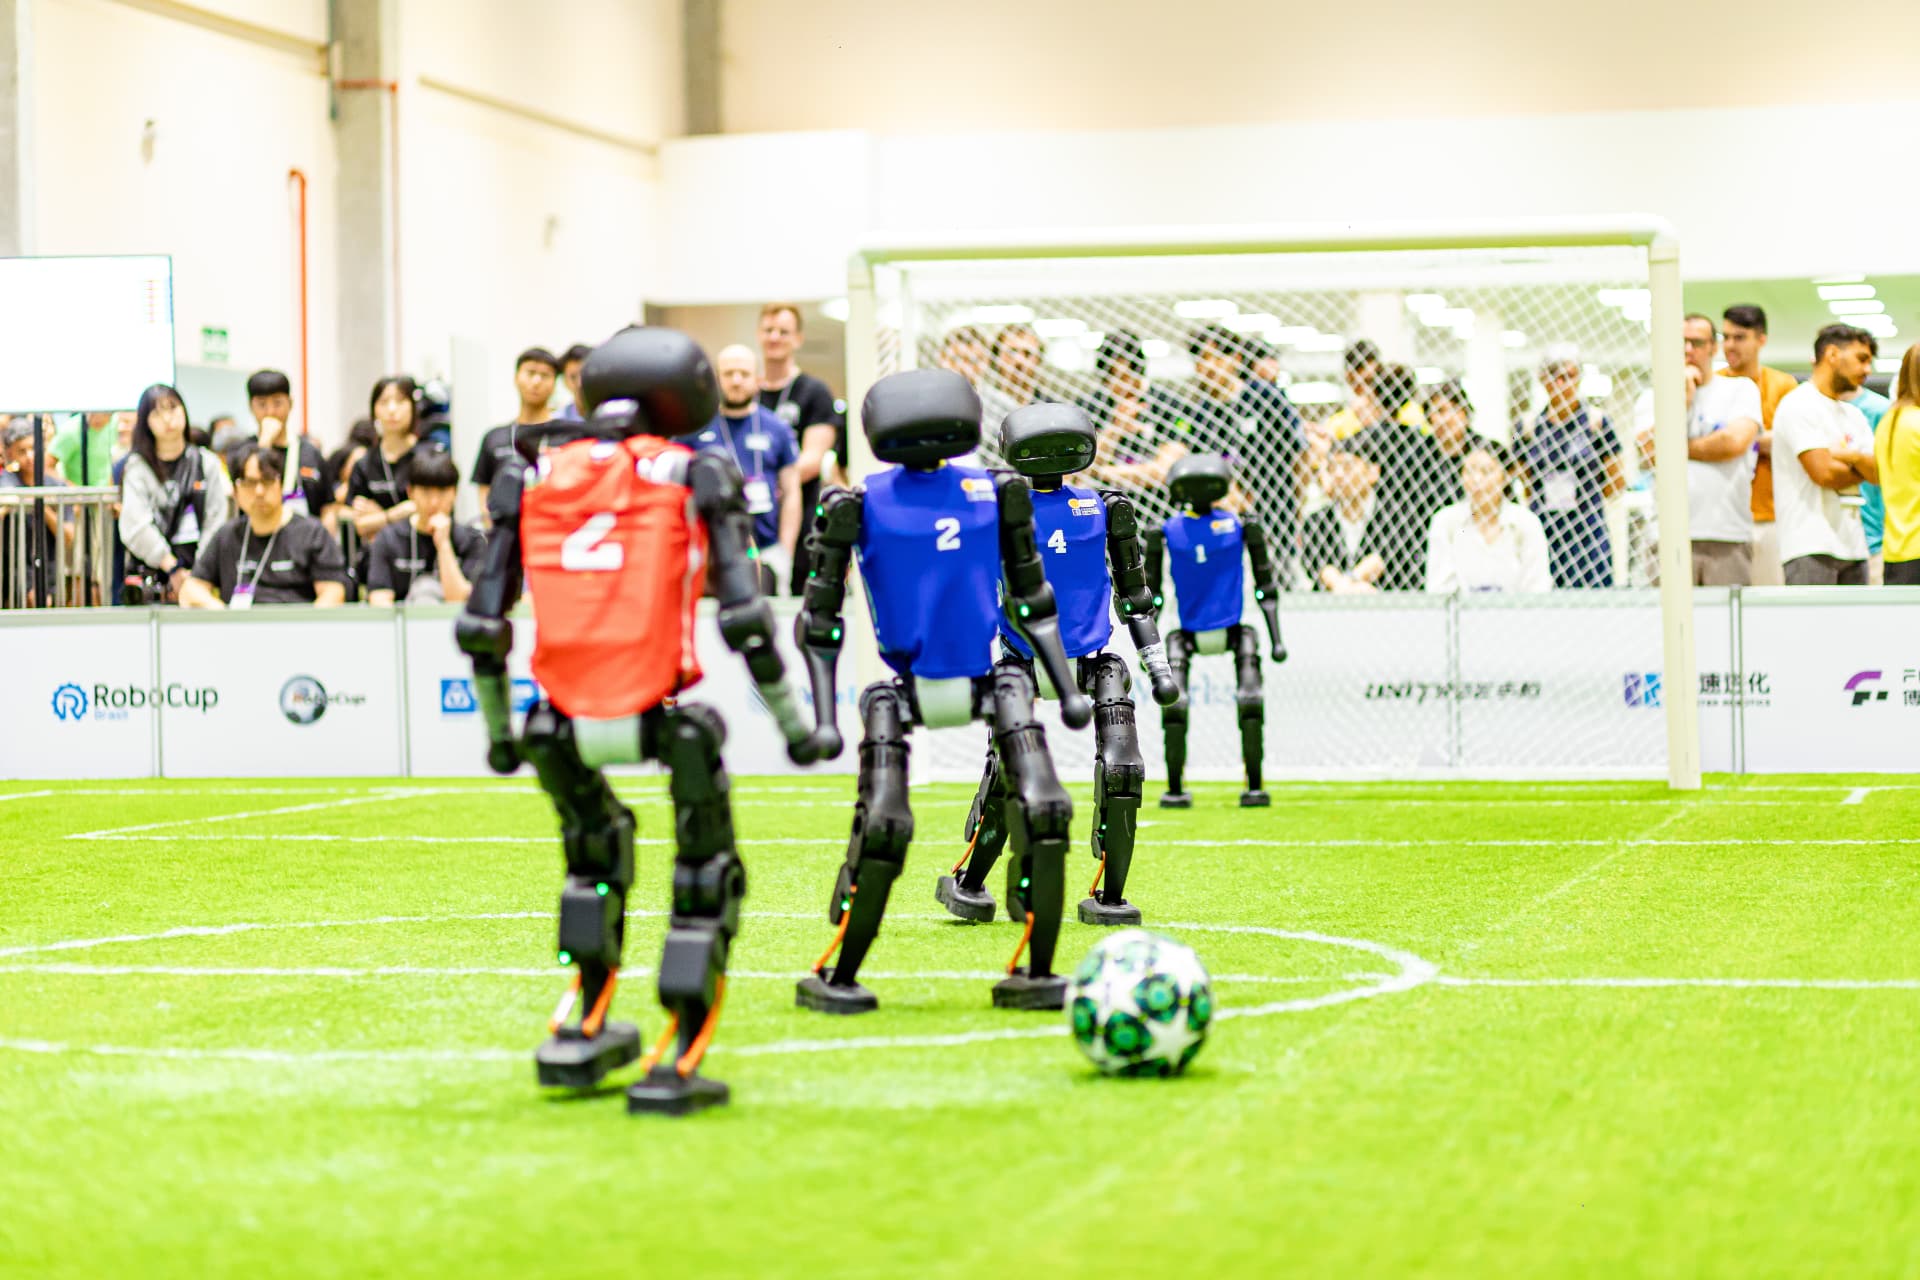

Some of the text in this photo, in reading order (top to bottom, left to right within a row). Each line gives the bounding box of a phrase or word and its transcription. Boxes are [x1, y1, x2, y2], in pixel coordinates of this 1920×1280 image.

[561, 512, 624, 571] 2
[934, 517, 961, 551] 2
[1047, 529, 1067, 554] 4
[1194, 544, 1207, 563] 1
[93, 683, 219, 713] RoboCup
